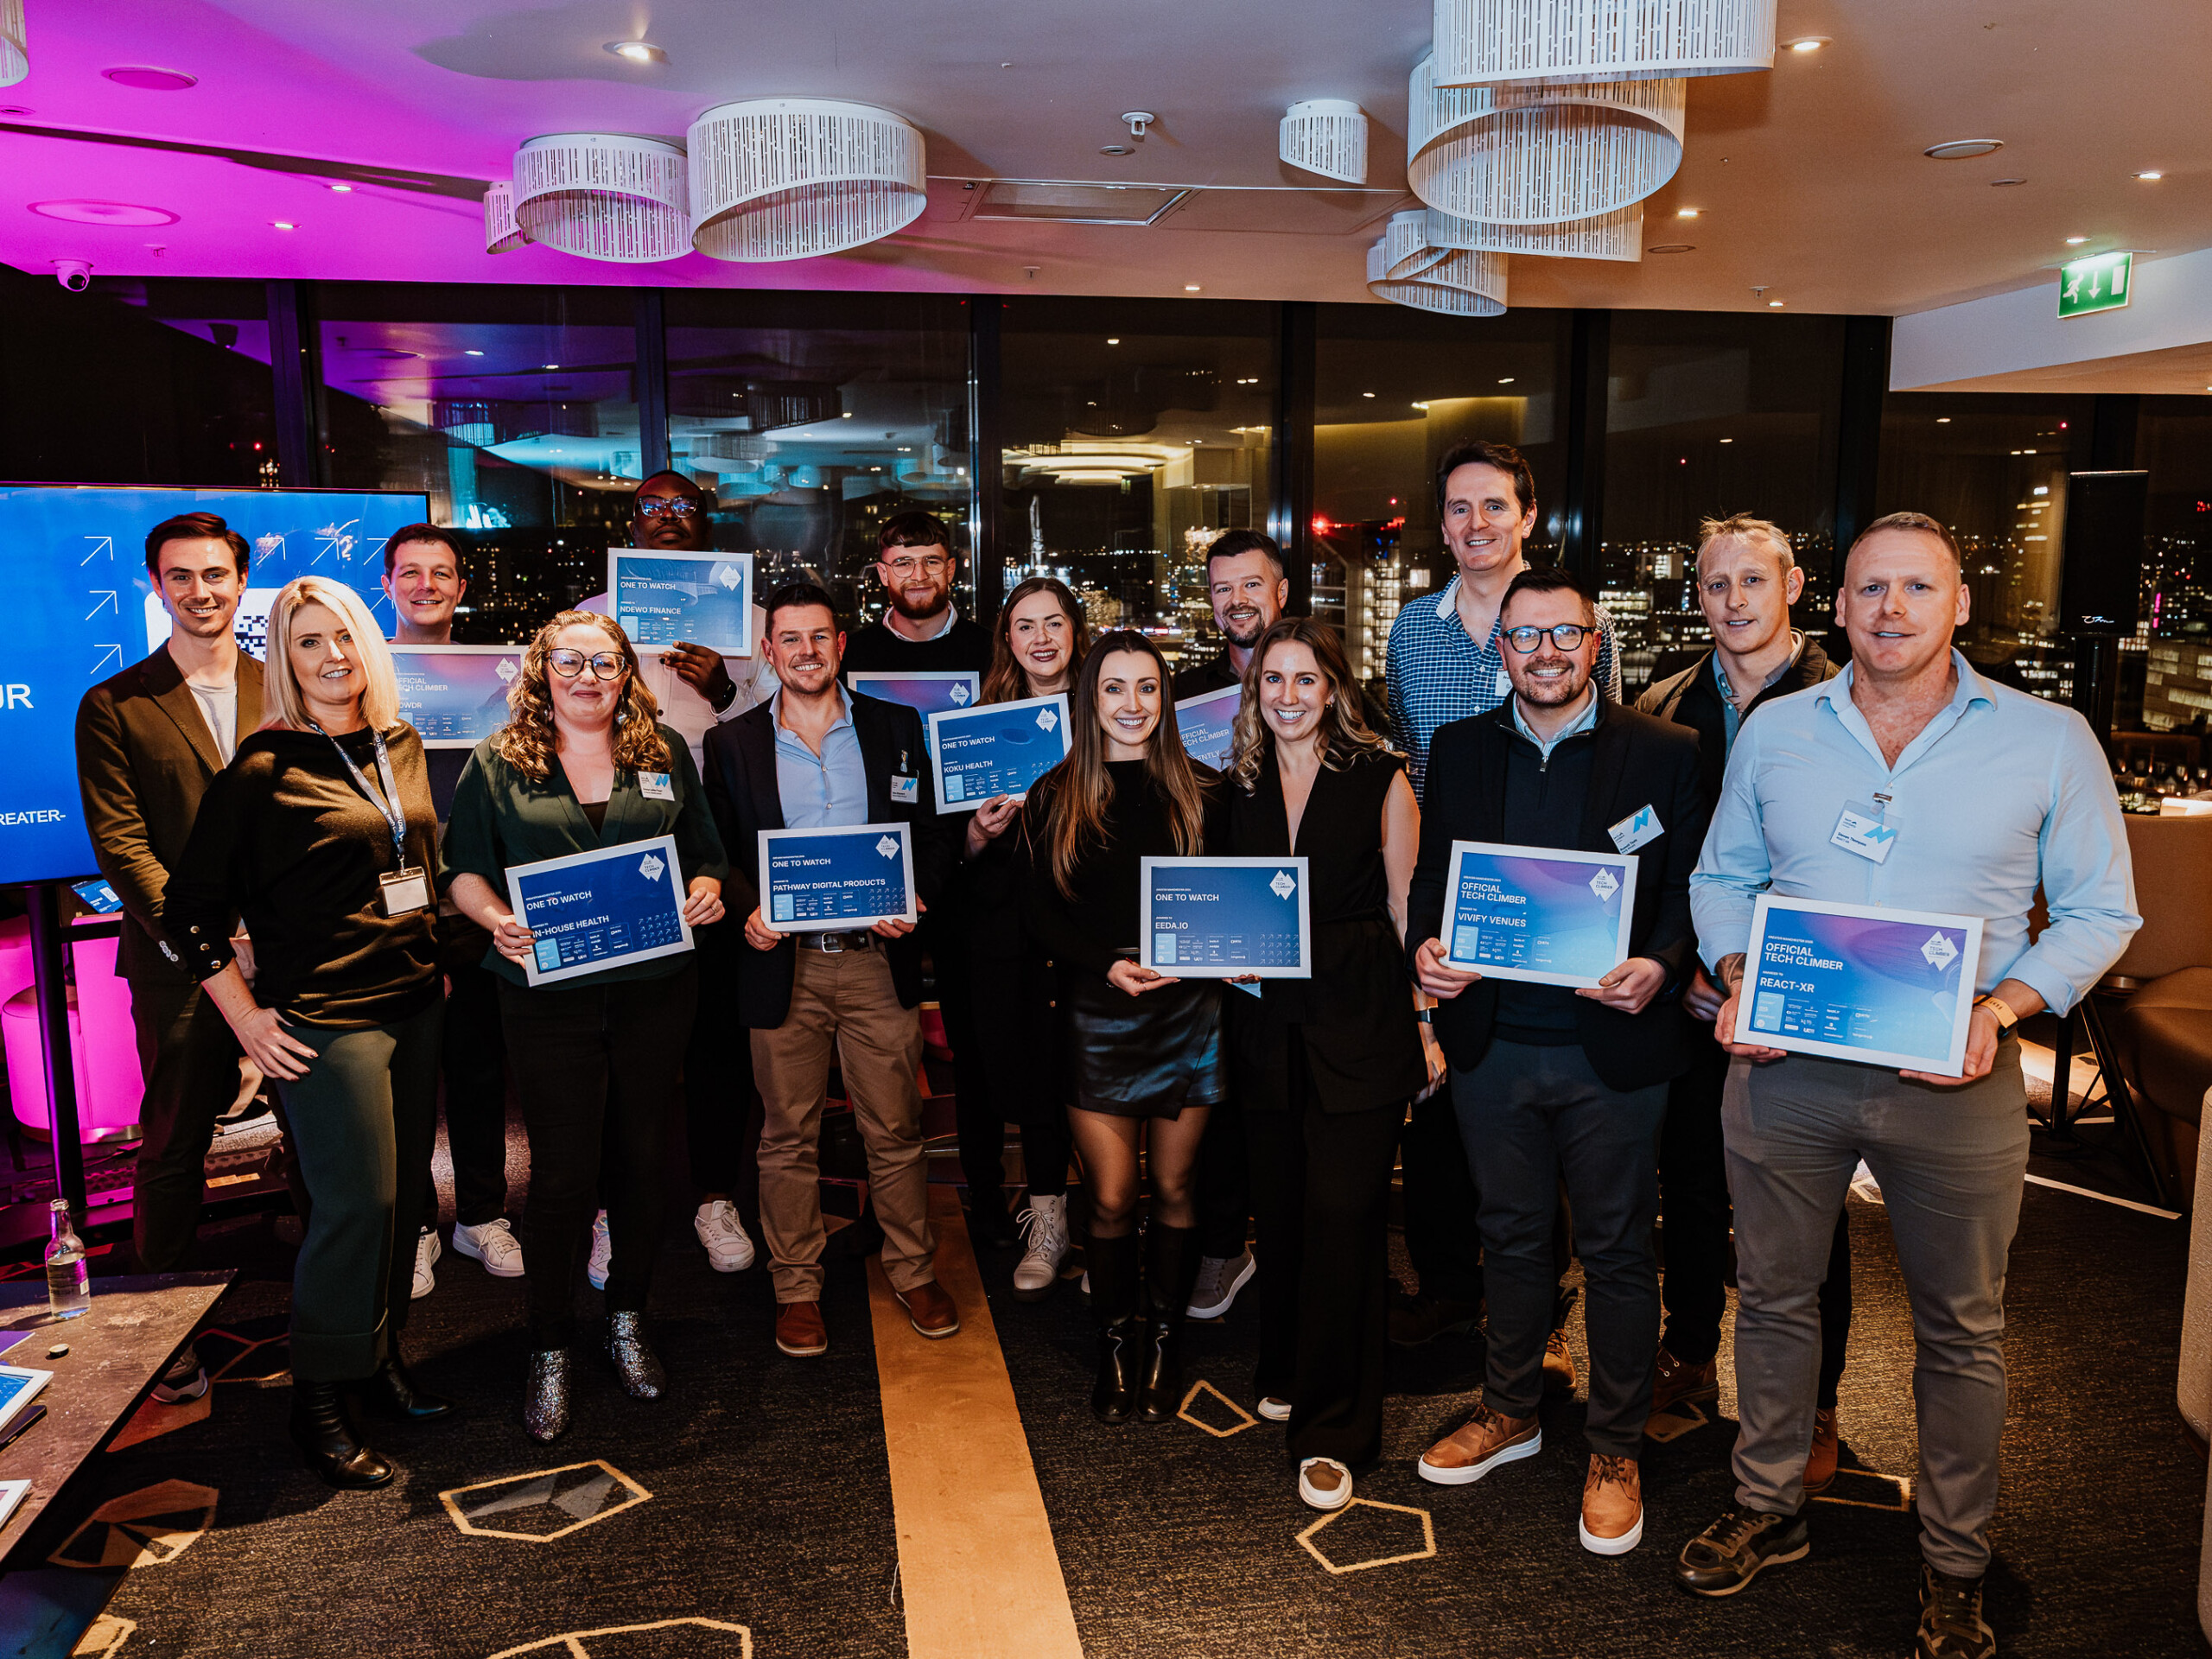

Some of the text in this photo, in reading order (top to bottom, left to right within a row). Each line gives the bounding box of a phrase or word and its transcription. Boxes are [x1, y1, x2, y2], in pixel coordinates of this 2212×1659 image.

[0, 683, 34, 709] R
[1179, 728, 1209, 741] FFICIAL
[1182, 729, 1230, 747] ECH CLIMBER
[942, 741, 957, 750] ONE
[969, 736, 995, 746] WATCH
[1195, 750, 1220, 760] ENTLY
[944, 765, 964, 773] KOKU
[965, 760, 993, 770] HEALTH
[773, 879, 886, 892] PATHWAY DIGITAL PRODUCTS
[1461, 882, 1502, 893] OFFICIAL
[526, 890, 593, 911] ONE TO WATCH
[1461, 890, 1527, 905] TECH CLIMBER
[532, 914, 610, 938] IN-HOUSE HEALTH
[1458, 912, 1527, 927] VIVIFY VENUES
[1765, 942, 1813, 957] OFFICIAL
[1764, 952, 1843, 970] TECH CLIMBER
[1760, 977, 1815, 993] REACT-XR
